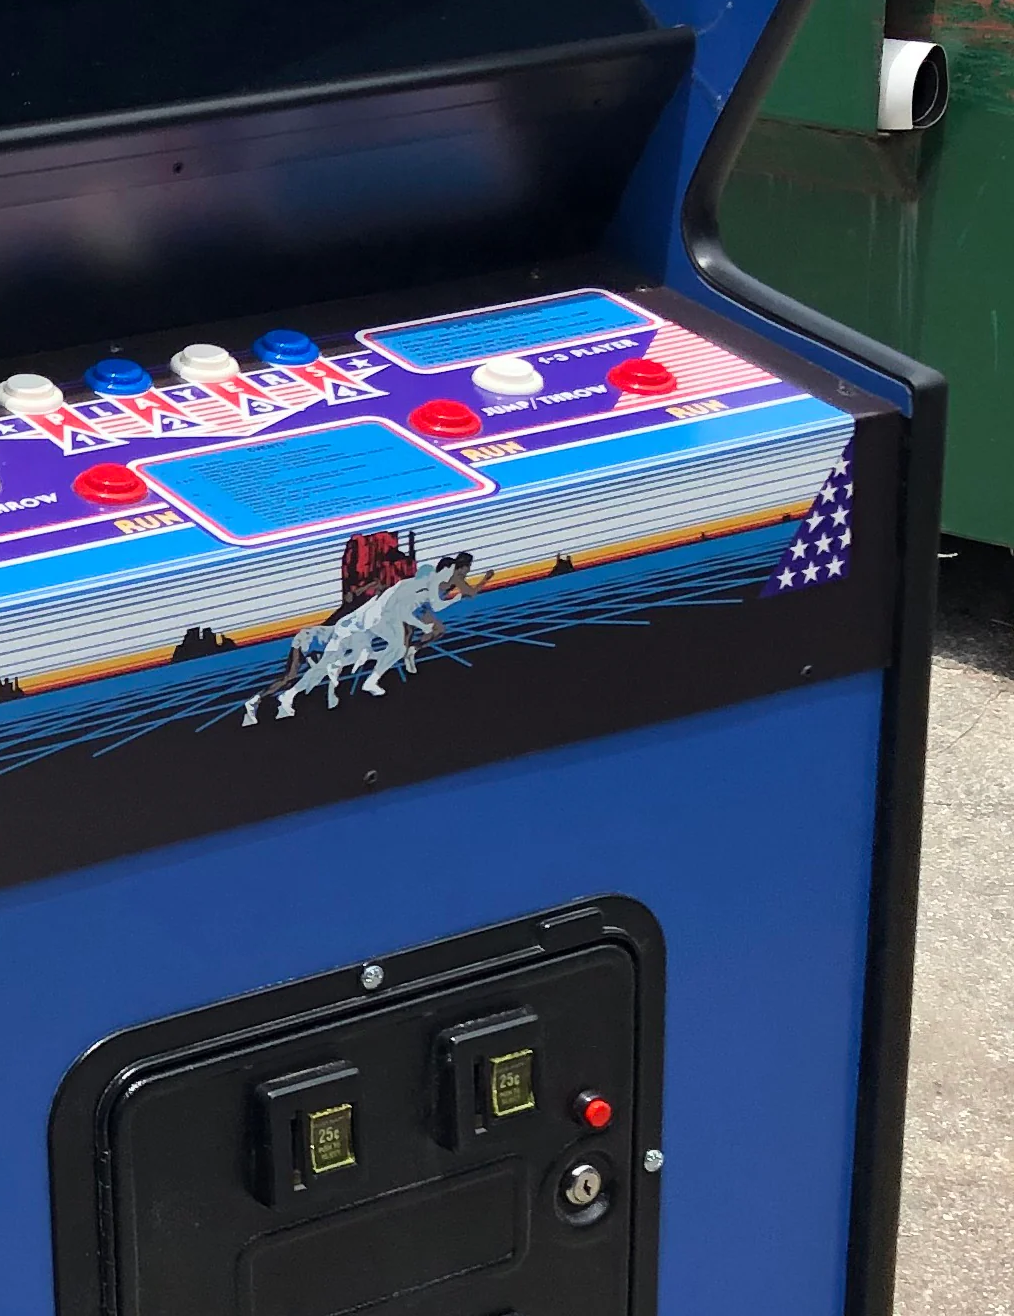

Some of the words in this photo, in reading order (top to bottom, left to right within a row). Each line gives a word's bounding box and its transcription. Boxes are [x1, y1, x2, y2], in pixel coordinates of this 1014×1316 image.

[569, 339, 639, 359] PLAYER
[480, 384, 608, 419] JUMP/THROW
[665, 400, 730, 421] RUN
[459, 441, 527, 463] RUN
[113, 510, 183, 535] RUN
